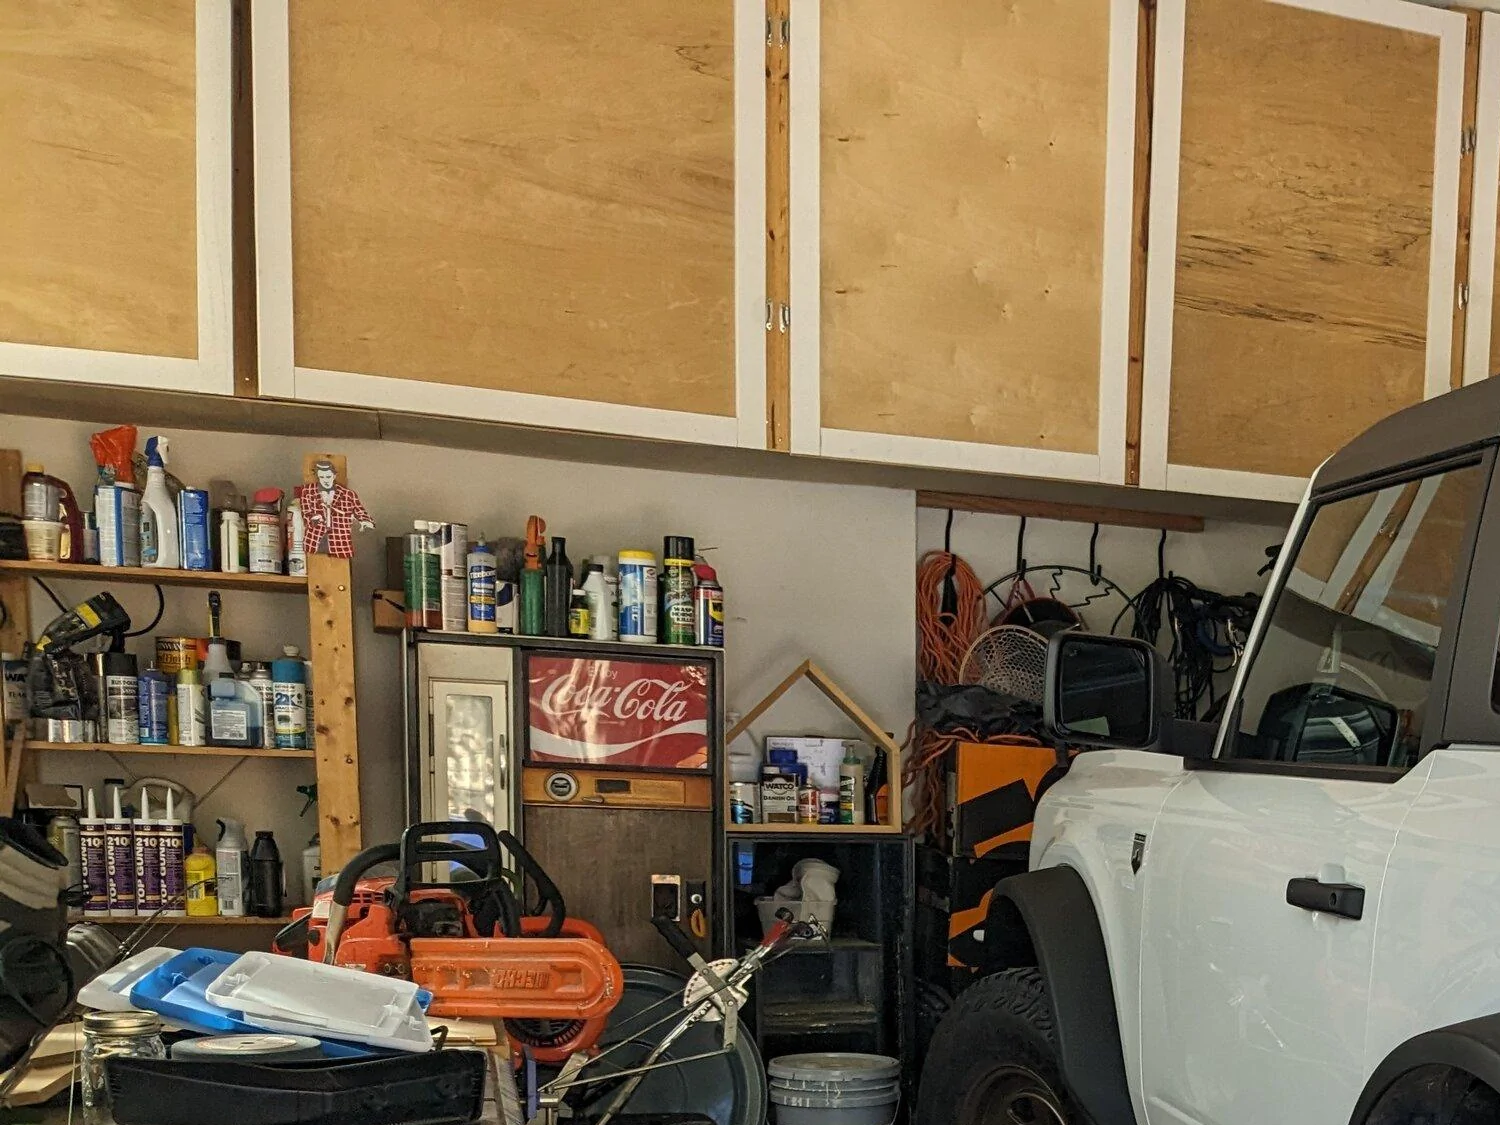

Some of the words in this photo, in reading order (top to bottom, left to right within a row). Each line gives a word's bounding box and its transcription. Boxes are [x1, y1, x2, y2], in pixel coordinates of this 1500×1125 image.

[542, 677, 694, 721] Coca-Cola
[765, 782, 794, 791] WATCO
[107, 846, 116, 876] GUN
[136, 847, 144, 877] GUN
[159, 847, 167, 877] GUN
